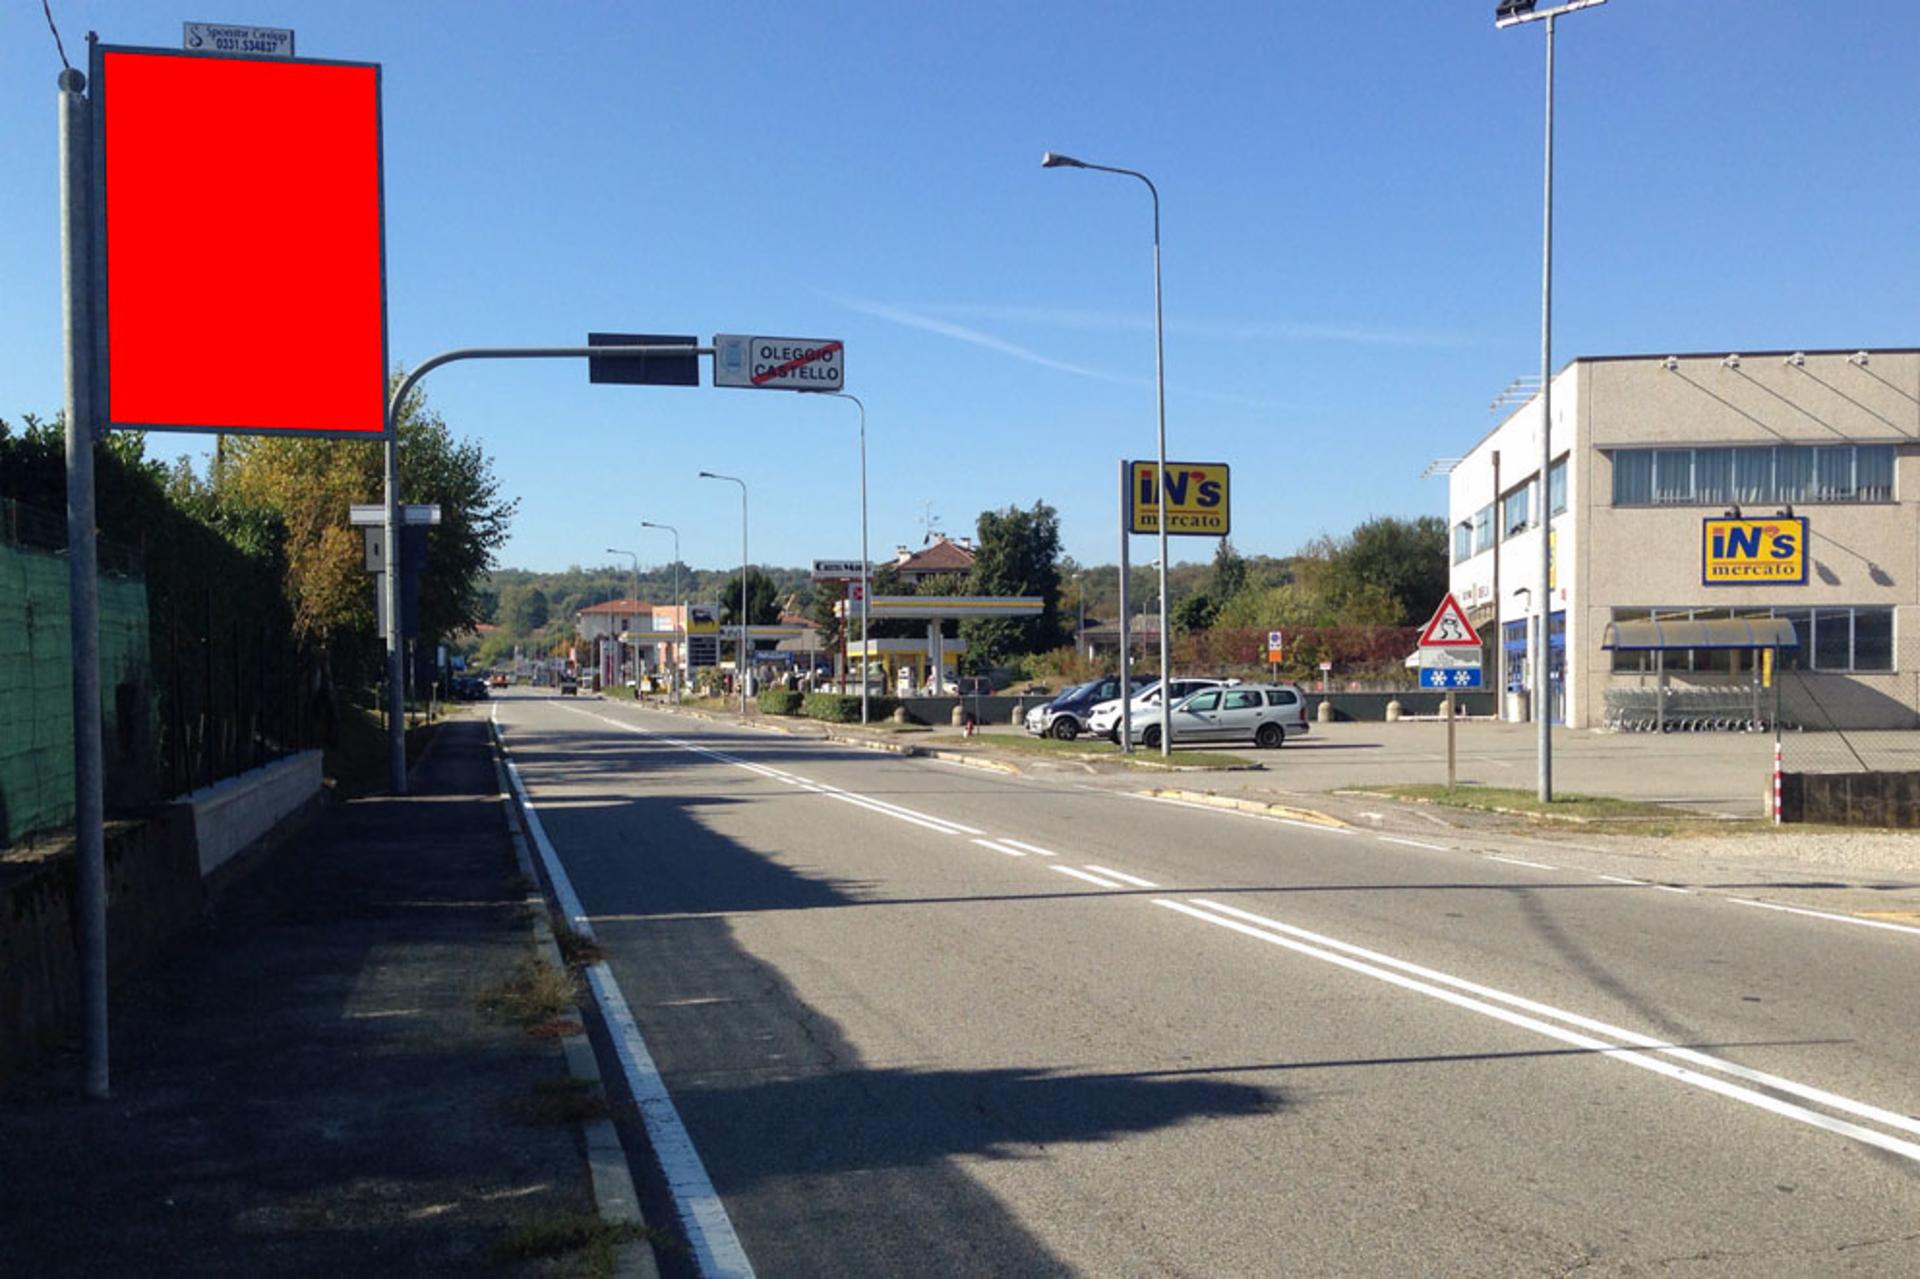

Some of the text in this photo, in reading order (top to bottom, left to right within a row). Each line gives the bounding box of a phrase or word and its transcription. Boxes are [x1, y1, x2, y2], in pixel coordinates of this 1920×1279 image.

[760, 346, 833, 362] OLEGGIO
[754, 364, 839, 380] CASTELLO
[1141, 514, 1220, 527] mrcato
[1712, 564, 1795, 576] mercato
